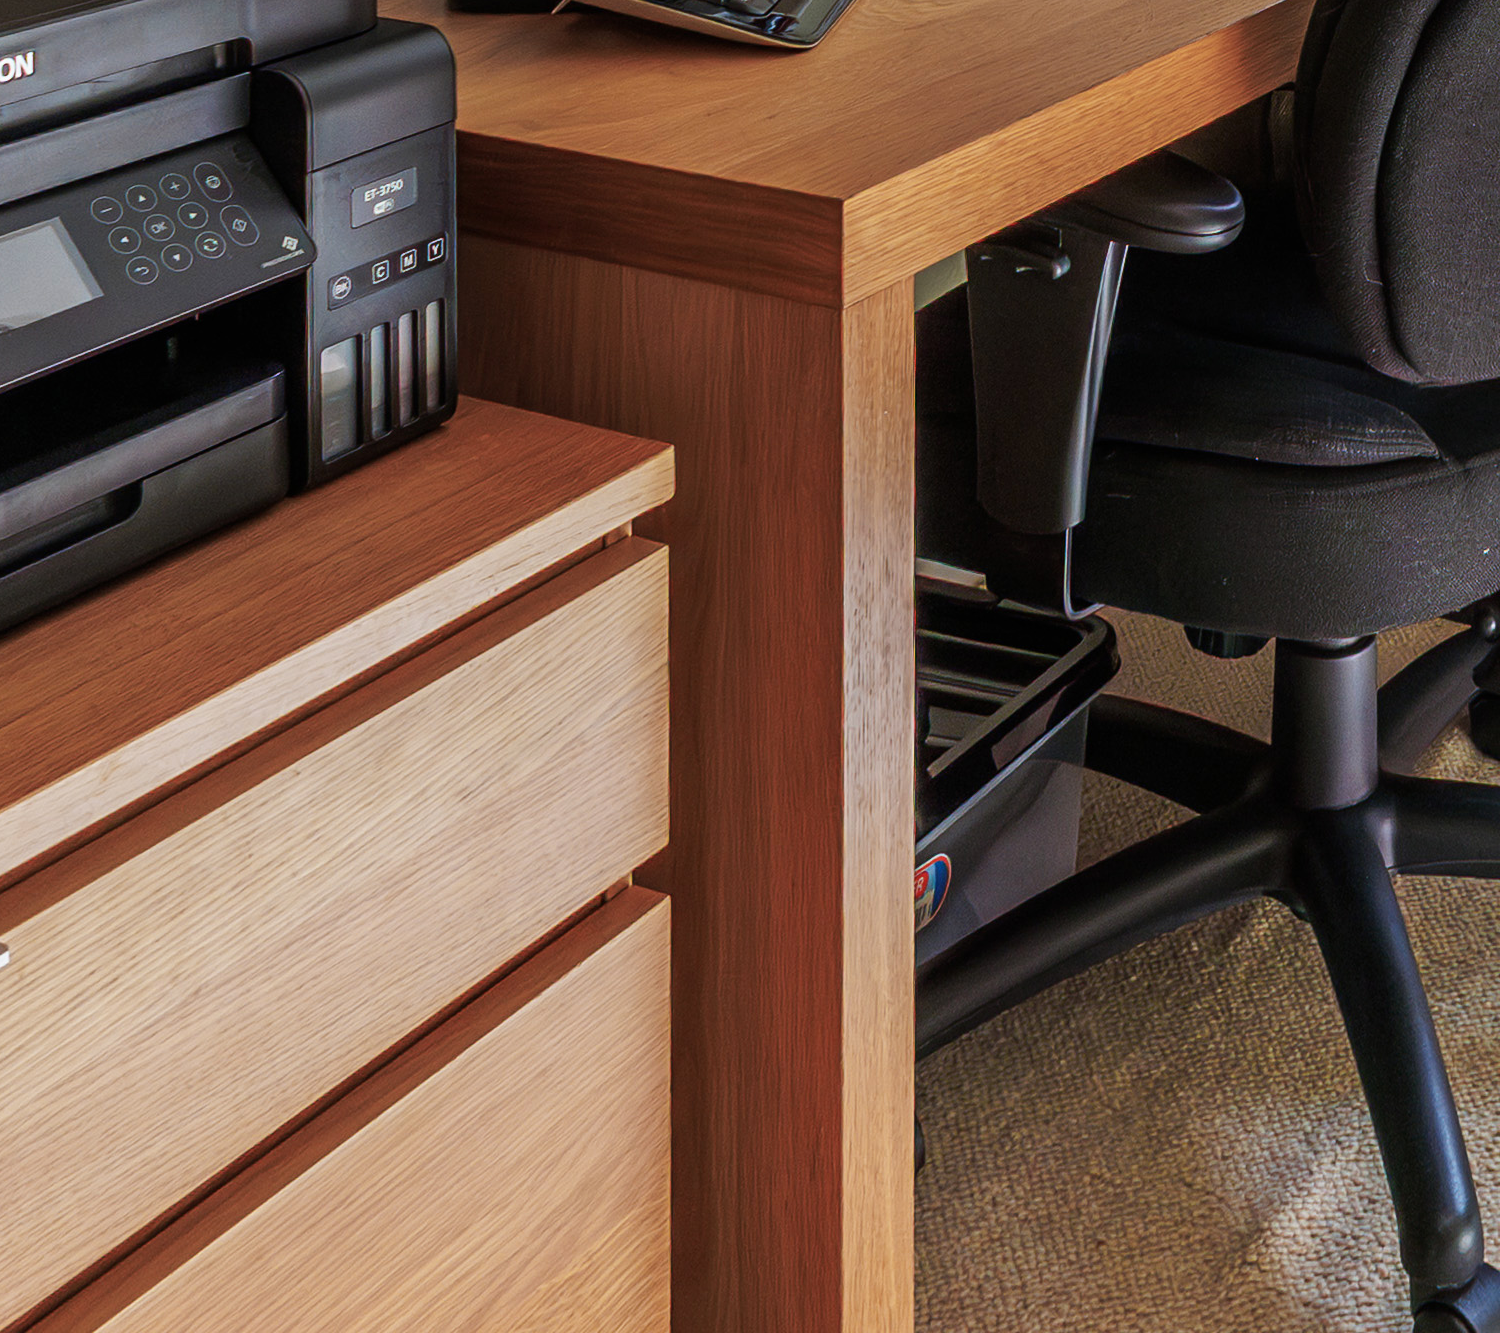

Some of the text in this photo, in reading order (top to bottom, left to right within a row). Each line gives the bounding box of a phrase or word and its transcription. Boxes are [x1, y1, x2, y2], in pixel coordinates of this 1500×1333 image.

[364, 179, 404, 202] ET-3750
[151, 221, 167, 233] OK
[431, 244, 440, 256] Y
[404, 253, 414, 268] M
[376, 266, 385, 278] C
